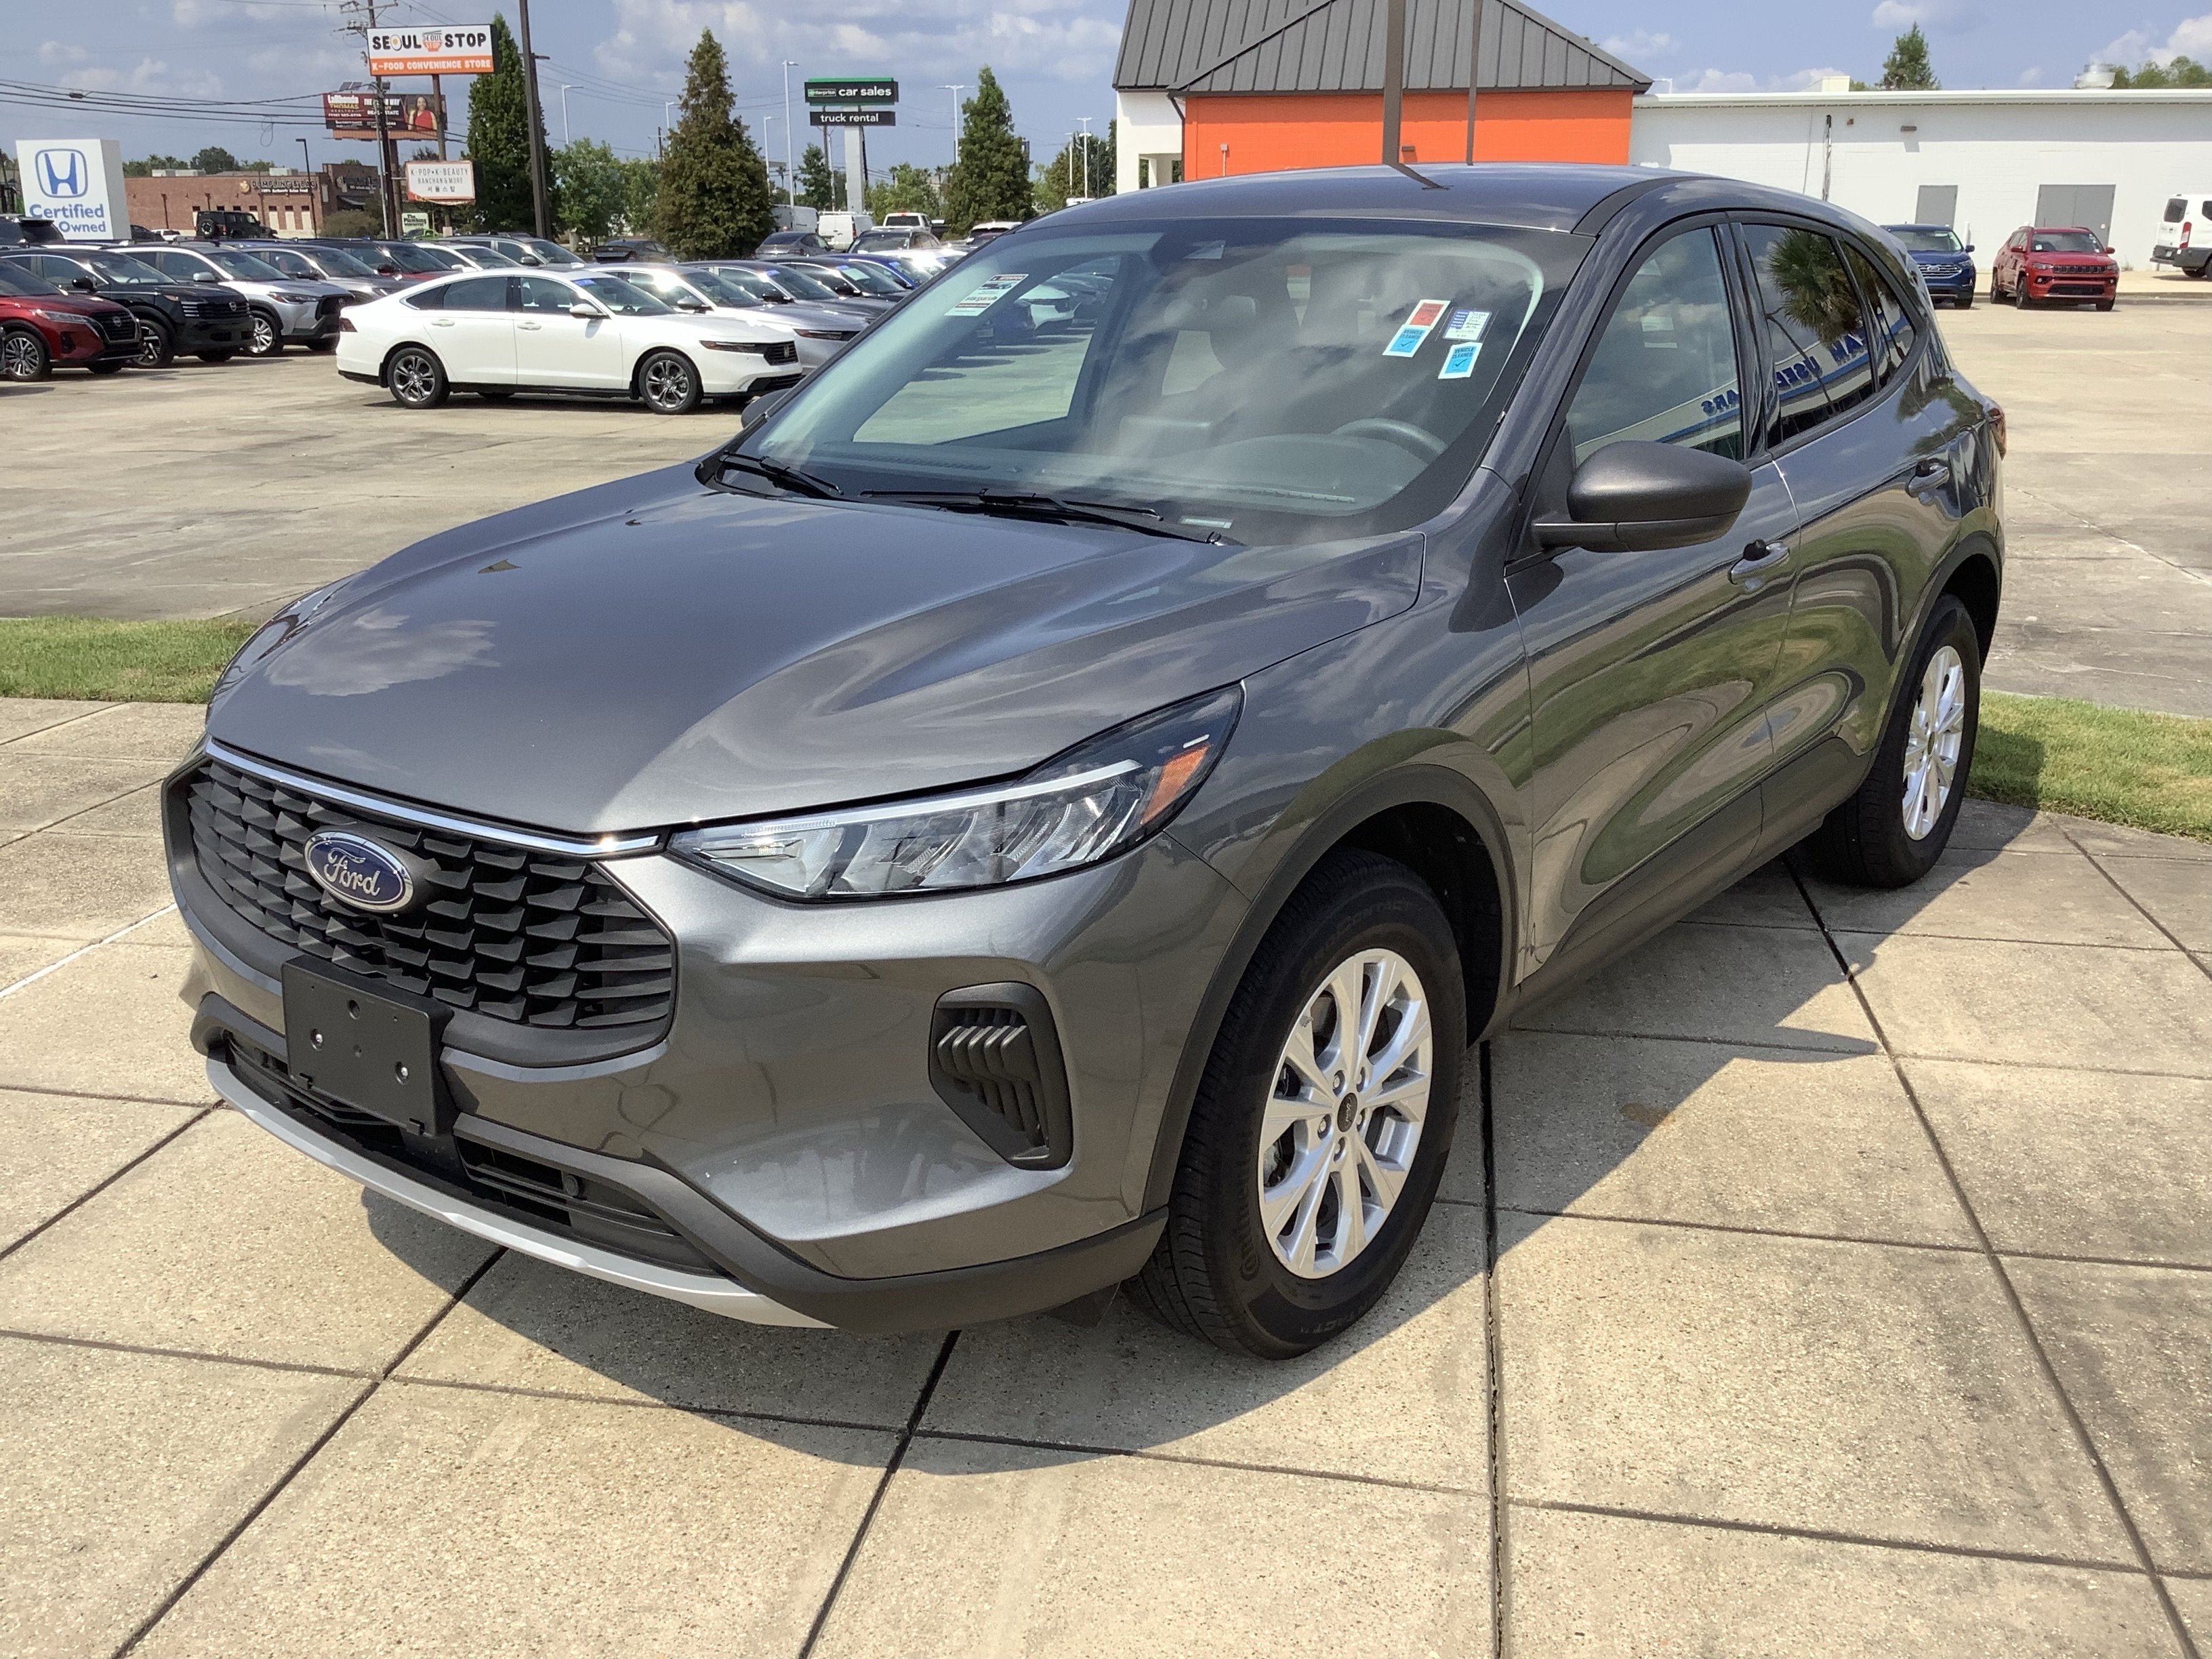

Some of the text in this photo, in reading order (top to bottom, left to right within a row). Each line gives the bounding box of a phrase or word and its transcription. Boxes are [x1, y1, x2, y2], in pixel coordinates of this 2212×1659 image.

[372, 33, 487, 51] SEOUL STOP
[372, 59, 491, 70] K-FOOD CONVENIENCE STORE
[838, 88, 858, 96] car
[860, 85, 892, 96] sales
[820, 113, 879, 122] truck rental
[29, 203, 104, 218] Certified
[324, 847, 381, 896] Ford
